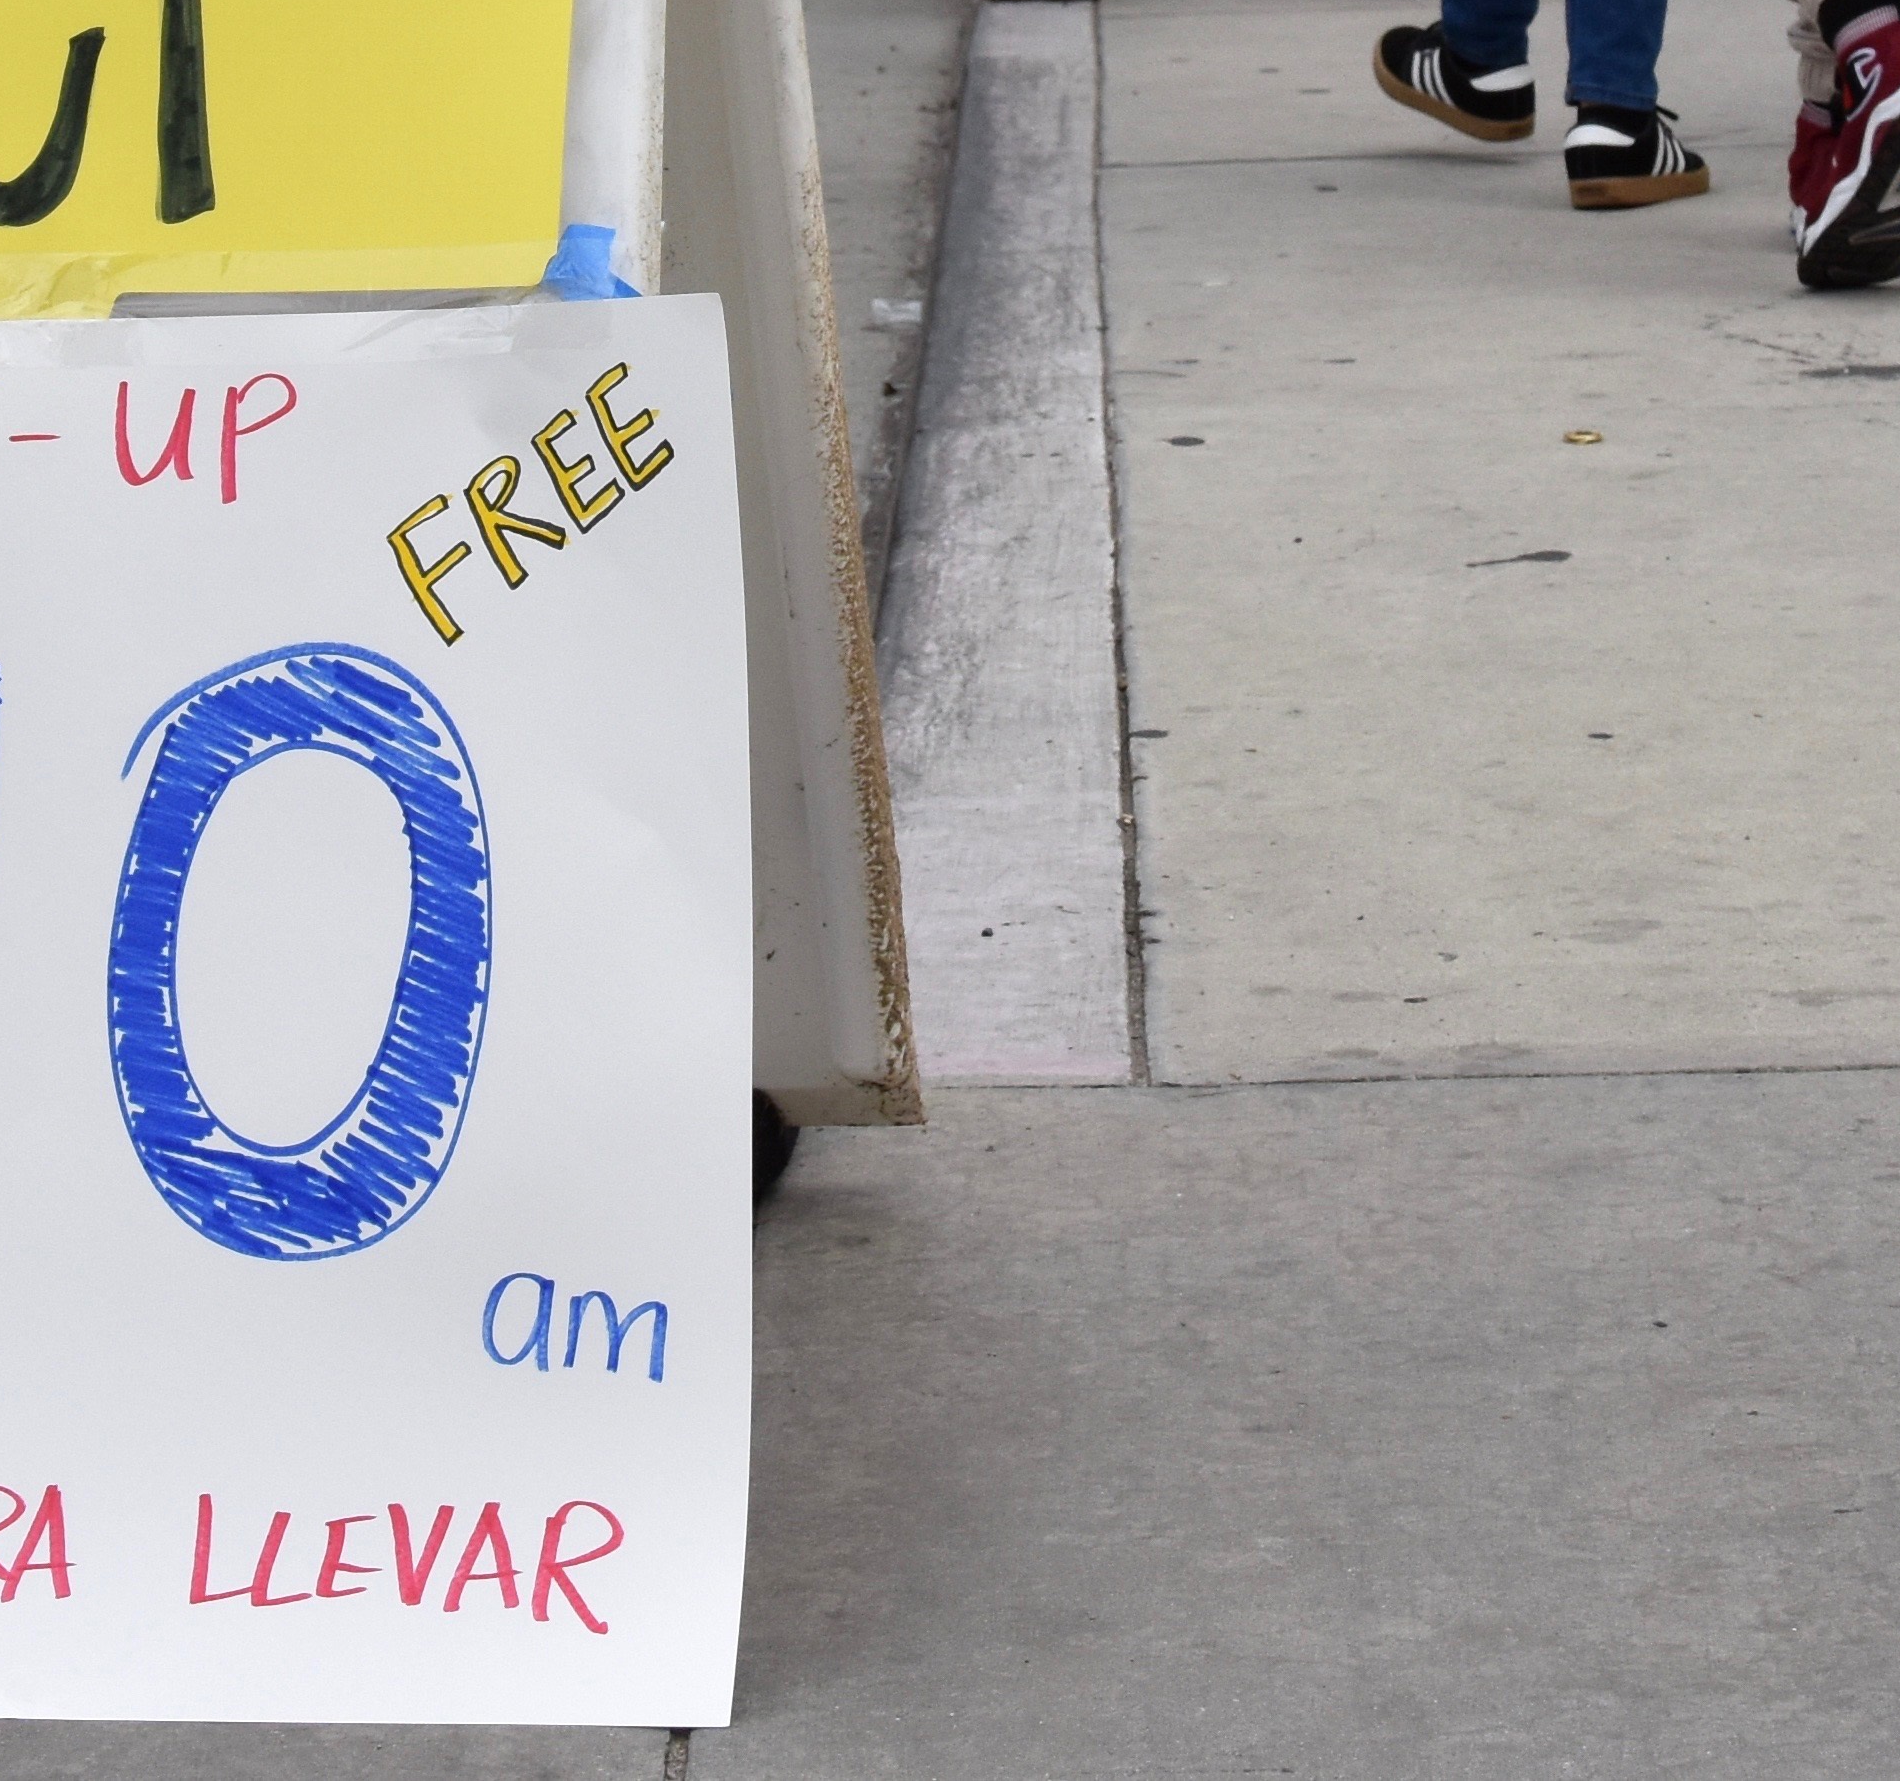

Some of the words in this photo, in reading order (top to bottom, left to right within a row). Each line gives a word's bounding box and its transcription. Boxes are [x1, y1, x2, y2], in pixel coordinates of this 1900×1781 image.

[386, 363, 676, 646] FREE
[481, 1271, 668, 1382] am
[189, 1493, 626, 1635] LLEVAR
